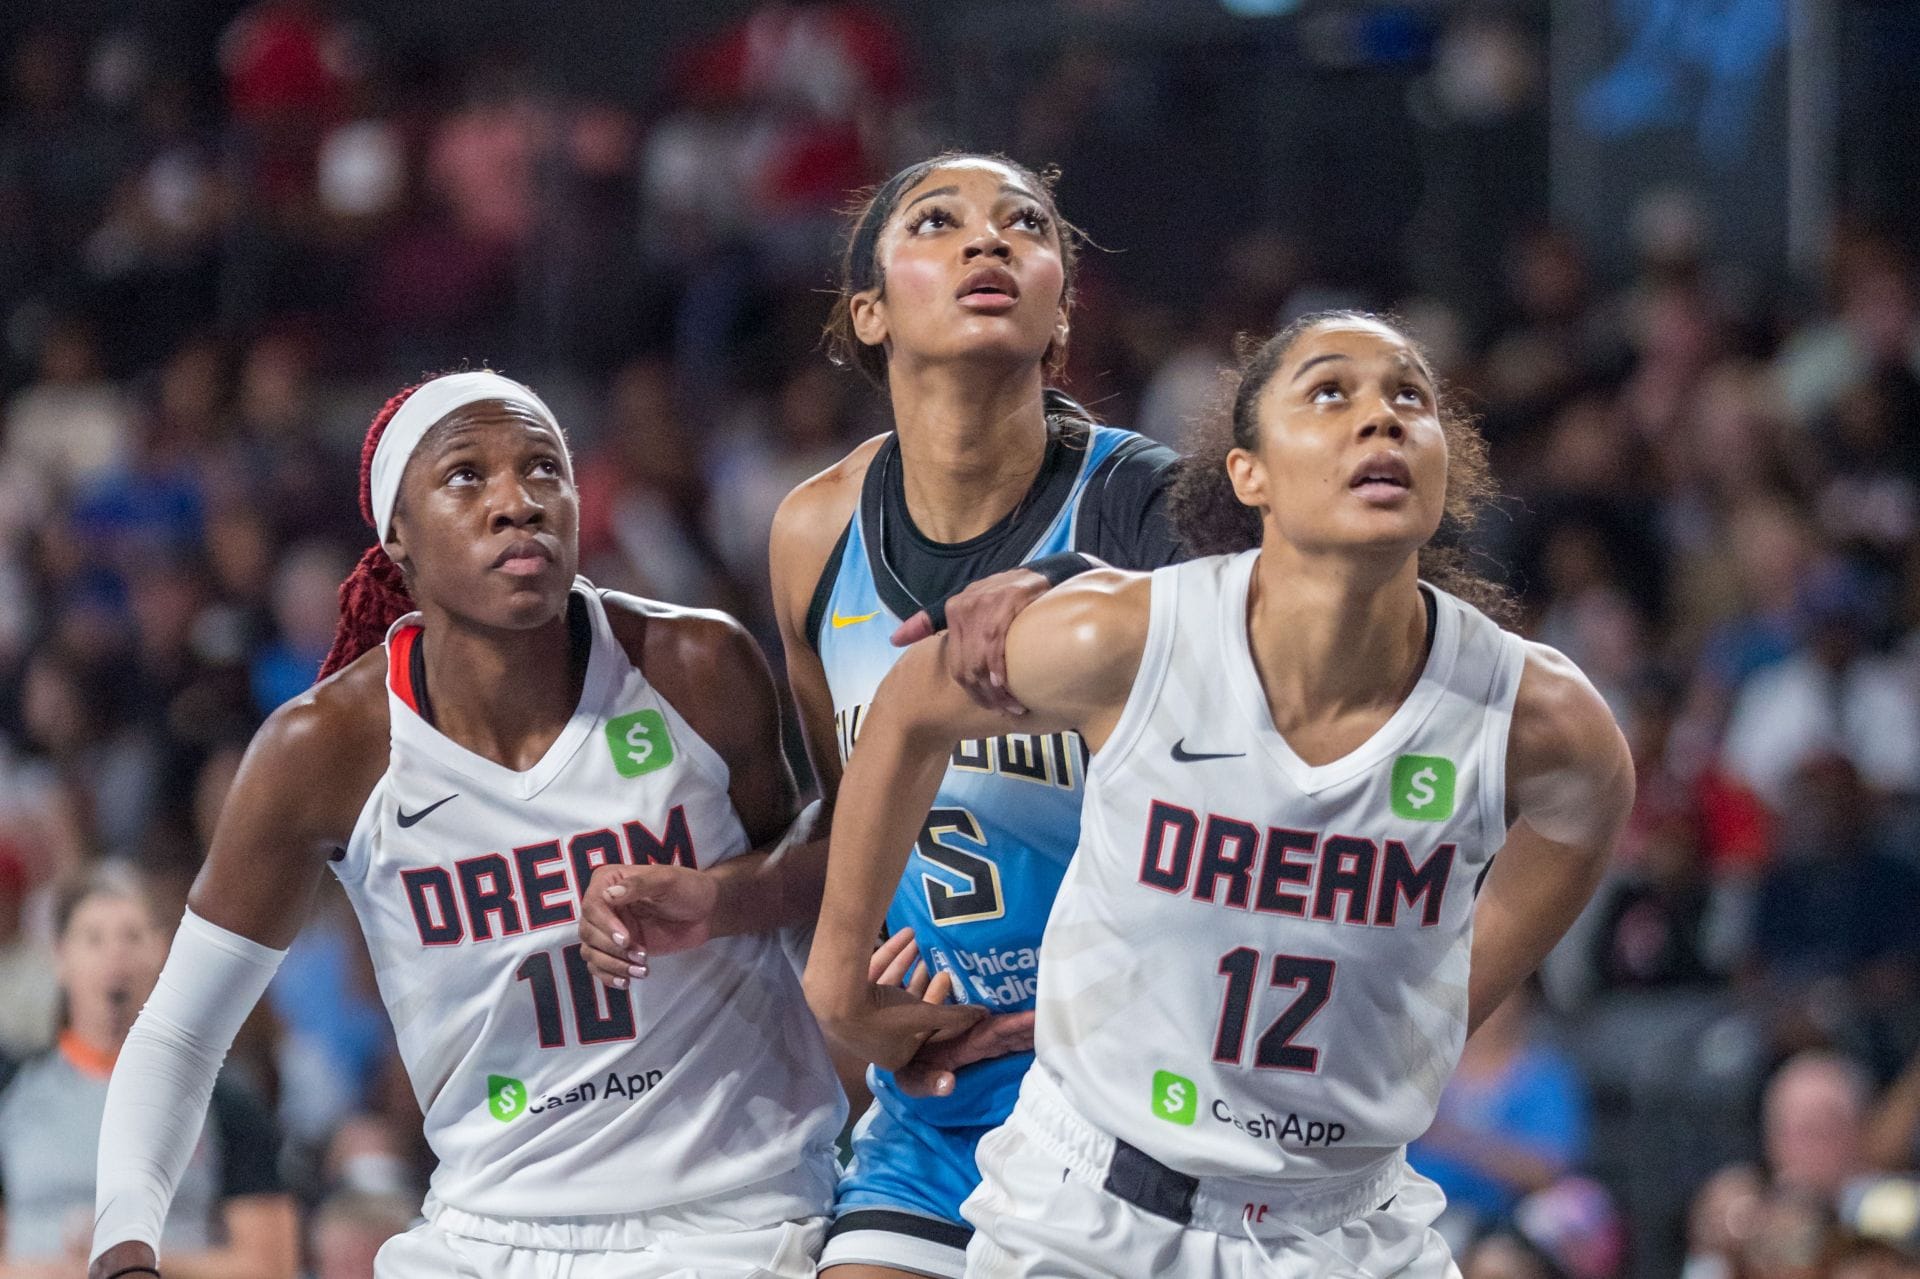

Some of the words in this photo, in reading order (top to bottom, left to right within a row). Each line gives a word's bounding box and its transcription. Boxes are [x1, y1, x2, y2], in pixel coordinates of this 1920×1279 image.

[1138, 798, 1457, 928] DREAM
[516, 942, 639, 1049] 10
[1211, 945, 1337, 1074] 12
[602, 1069, 663, 1101] App
